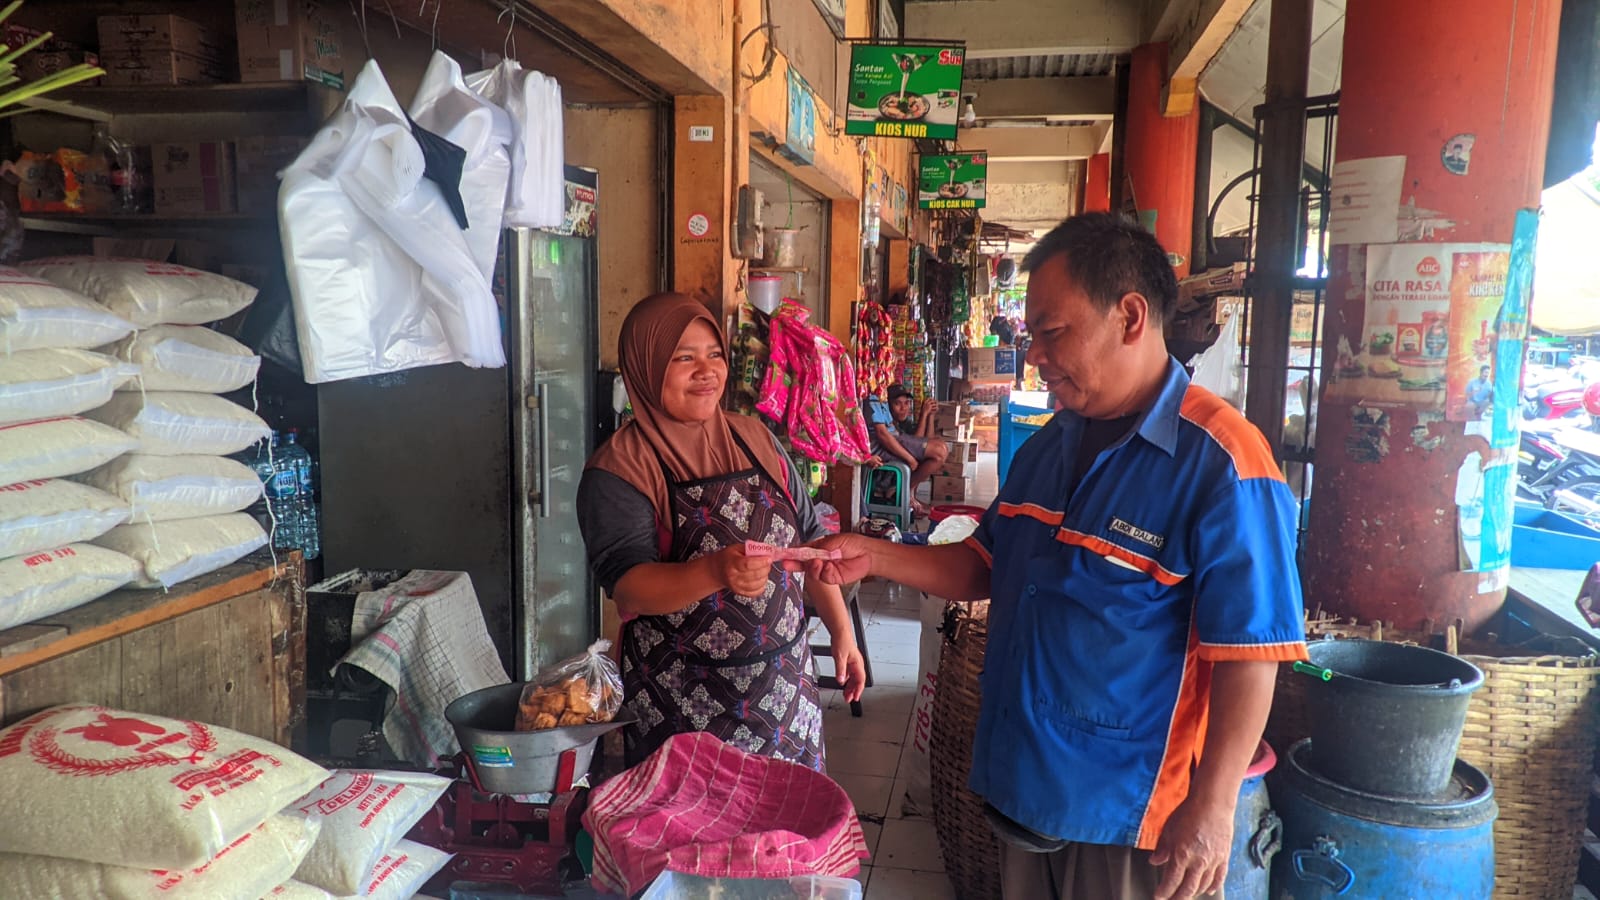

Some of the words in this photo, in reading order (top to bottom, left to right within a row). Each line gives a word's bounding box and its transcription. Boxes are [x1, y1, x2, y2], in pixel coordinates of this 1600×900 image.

[854, 63, 885, 73] Santan
[875, 122, 902, 136] KIOS
[904, 123, 928, 138] NUR
[929, 199, 946, 209] KIOS
[946, 199, 960, 208] CAK
[961, 199, 976, 208] NUR
[1418, 264, 1440, 273] ABC
[1373, 280, 1400, 292] CITA
[1405, 280, 1443, 292] RASA
[1133, 528, 1161, 547] DALAN
[357, 794, 377, 812] NETTO
